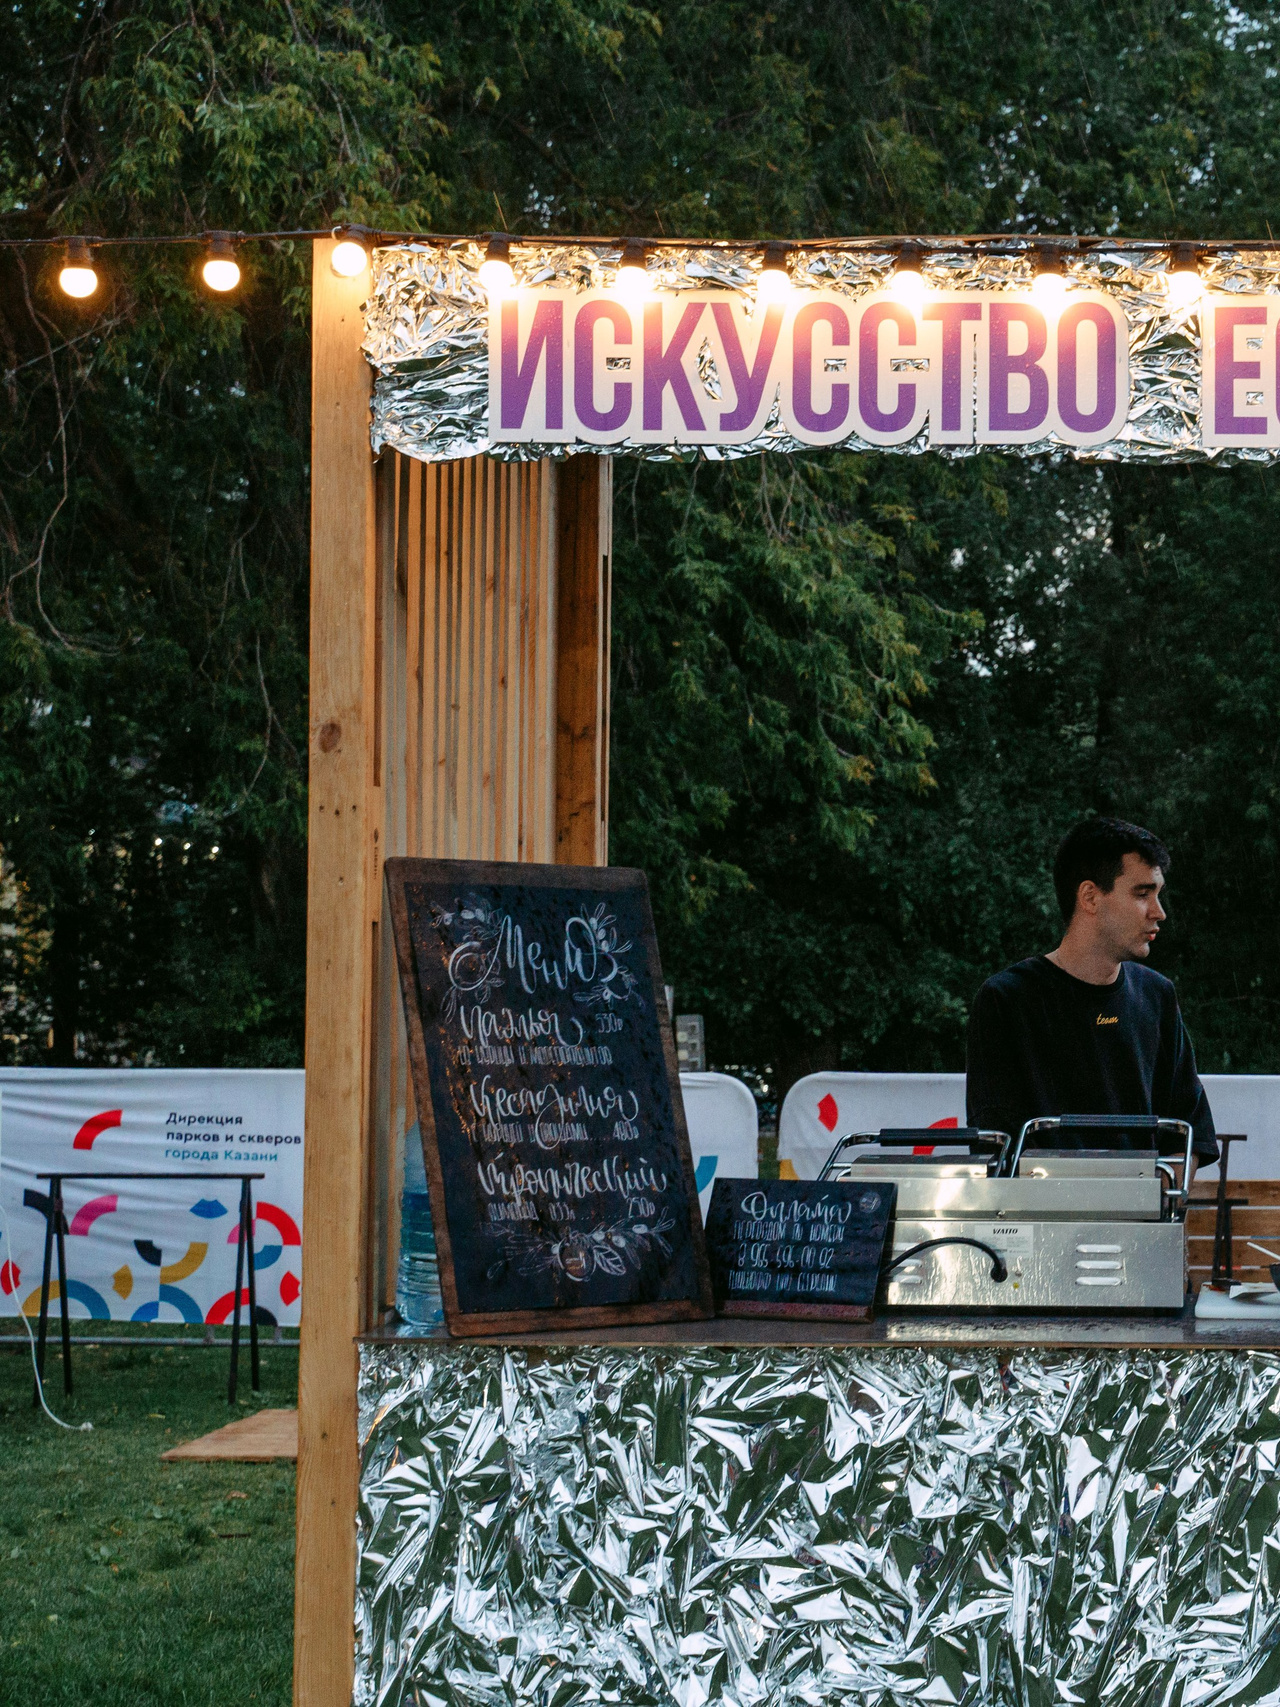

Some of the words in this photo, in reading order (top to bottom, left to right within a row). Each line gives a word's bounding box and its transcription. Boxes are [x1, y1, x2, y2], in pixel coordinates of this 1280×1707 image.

[500, 300, 1116, 434] ИСКУССТВО
[166, 1112, 243, 1126] Дирекция
[167, 1132, 220, 1143] парков
[225, 1134, 234, 1142] и
[239, 1134, 301, 1146] скверов
[165, 1149, 219, 1161] города
[224, 1150, 278, 1161] Казани
